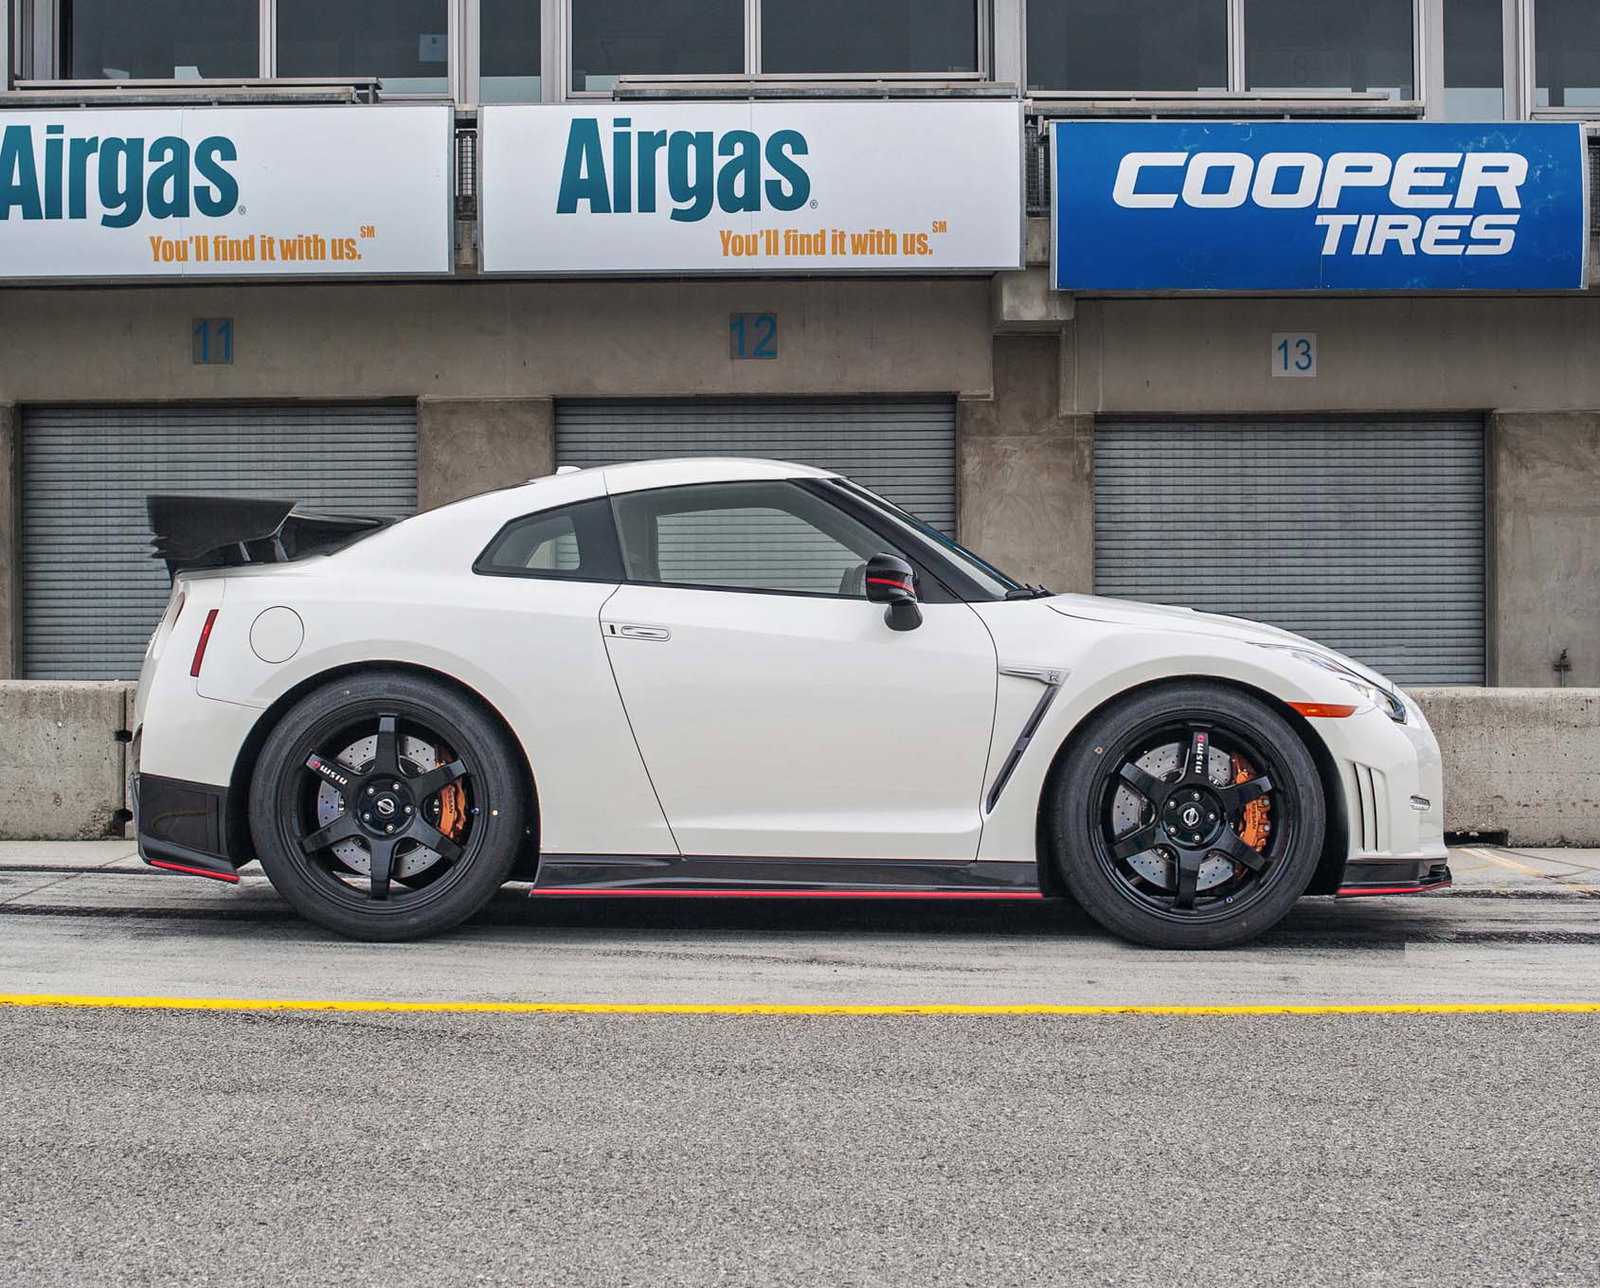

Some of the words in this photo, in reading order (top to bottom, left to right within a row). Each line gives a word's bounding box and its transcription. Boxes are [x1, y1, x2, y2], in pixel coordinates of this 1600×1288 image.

[0, 124, 239, 228] Airgas
[556, 117, 811, 222] Airgas
[1112, 152, 1528, 208] COOPER
[150, 235, 210, 262] You'll
[213, 235, 256, 262] find
[260, 235, 277, 261] it
[279, 234, 327, 261] with
[331, 240, 362, 261] us.
[360, 226, 375, 239] SM
[719, 229, 780, 257] You'll
[784, 228, 827, 256] find
[831, 229, 847, 256] it
[850, 229, 898, 256] with
[902, 234, 933, 256] us.
[932, 220, 947, 233] SM
[1315, 214, 1521, 255] TIRES
[194, 320, 233, 363] 11
[731, 314, 777, 358] 12
[1277, 338, 1313, 371] 13
